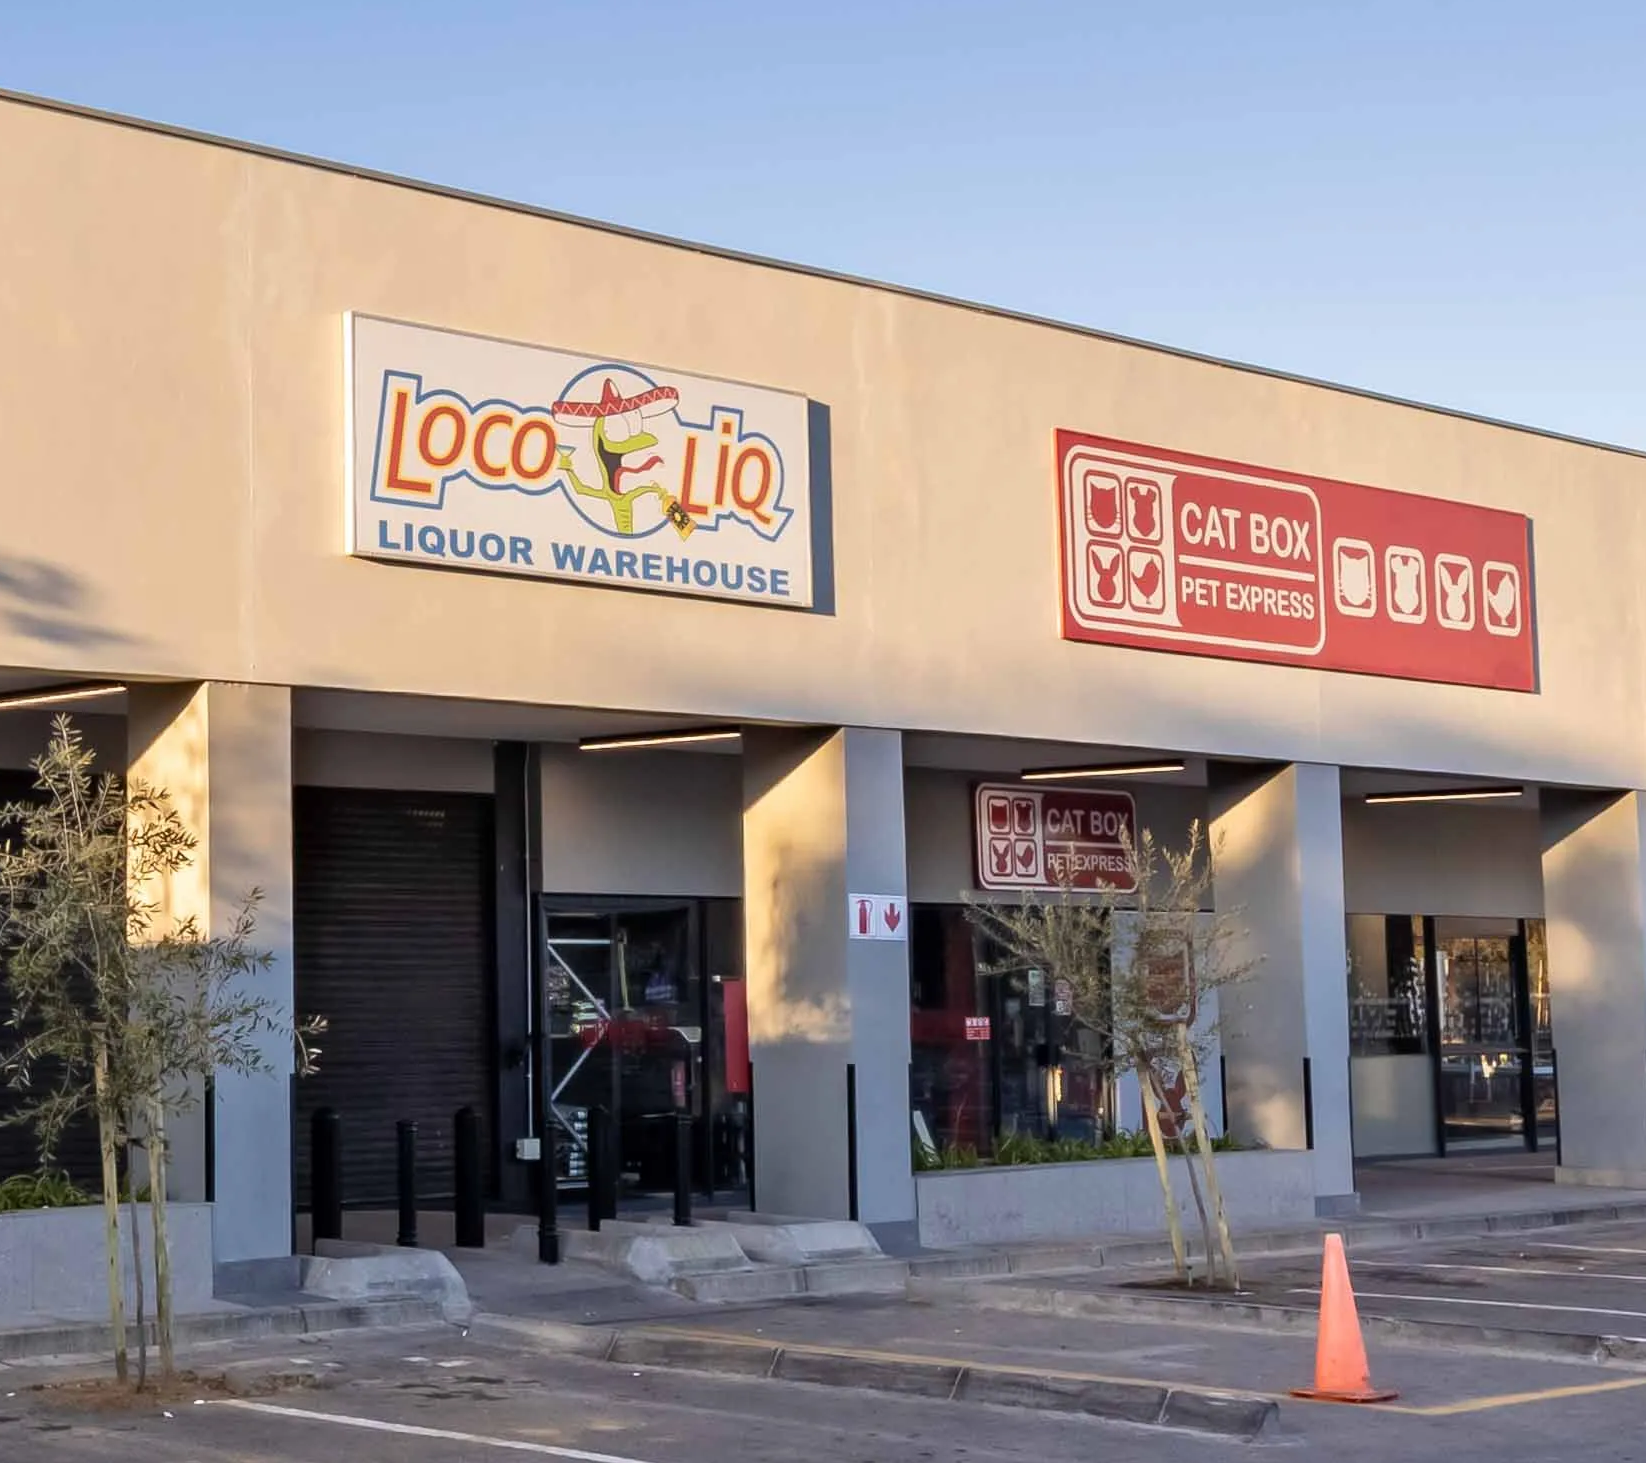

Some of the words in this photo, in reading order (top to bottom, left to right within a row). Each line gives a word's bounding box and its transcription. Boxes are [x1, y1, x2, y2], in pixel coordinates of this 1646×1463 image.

[379, 519, 534, 567] LIQUOR
[551, 541, 790, 597] WAREHOUSE
[1180, 502, 1241, 551] CAT
[1250, 512, 1311, 562] BOX
[1181, 576, 1220, 607] PET
[1226, 583, 1315, 621] EXPRESS
[1047, 807, 1085, 835] CAT
[1090, 810, 1129, 843] BOX
